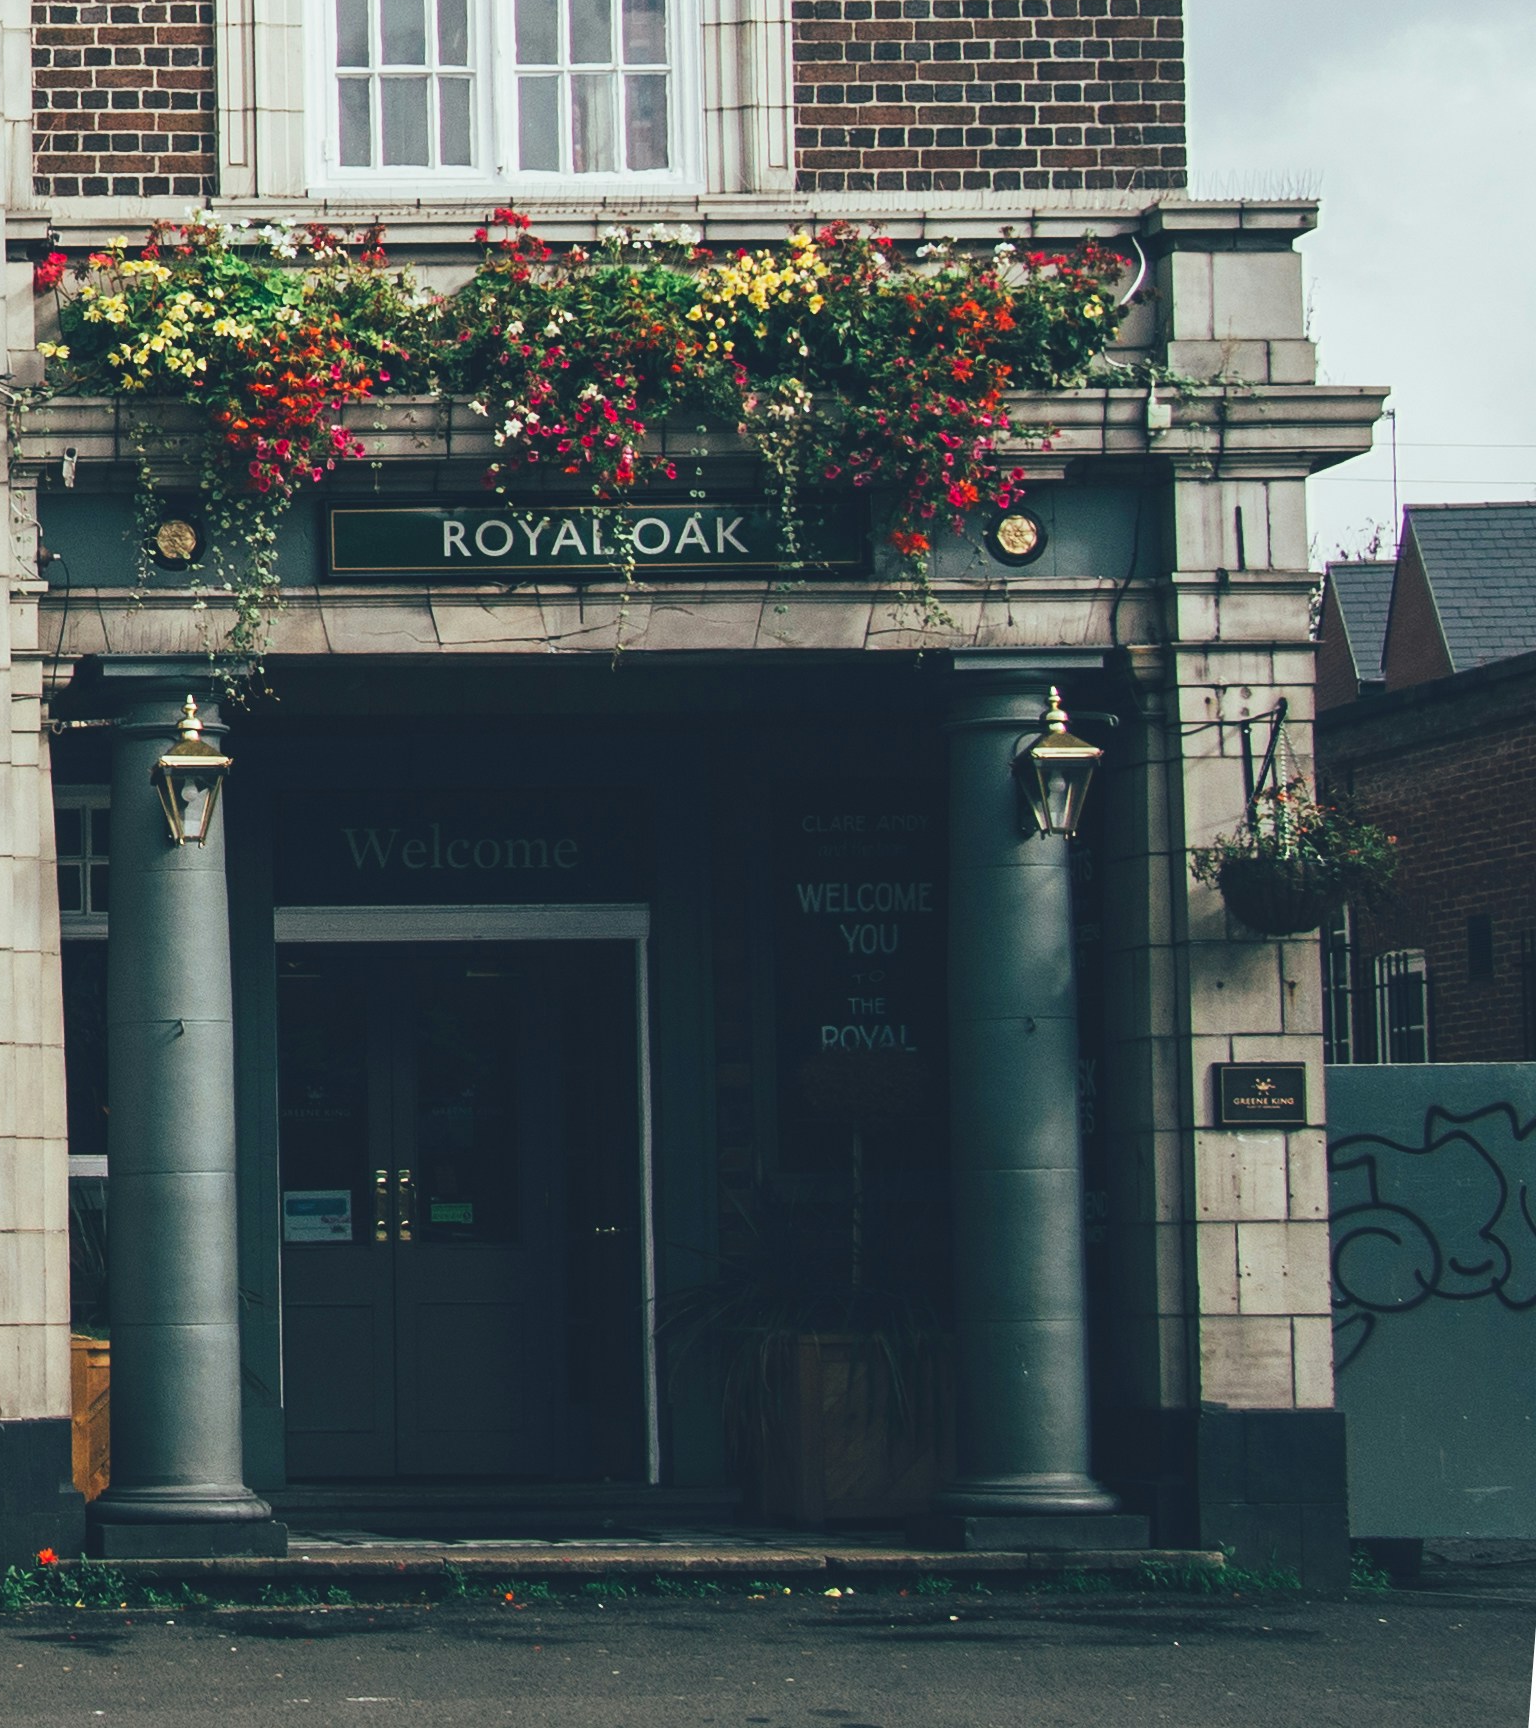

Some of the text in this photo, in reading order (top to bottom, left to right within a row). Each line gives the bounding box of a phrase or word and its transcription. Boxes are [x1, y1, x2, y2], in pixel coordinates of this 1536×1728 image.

[442, 516, 749, 557] ROYAL OAK
[340, 822, 580, 871] Welcome
[796, 882, 933, 913] WELCOME
[839, 923, 899, 954] YOU
[847, 997, 886, 1015] THE
